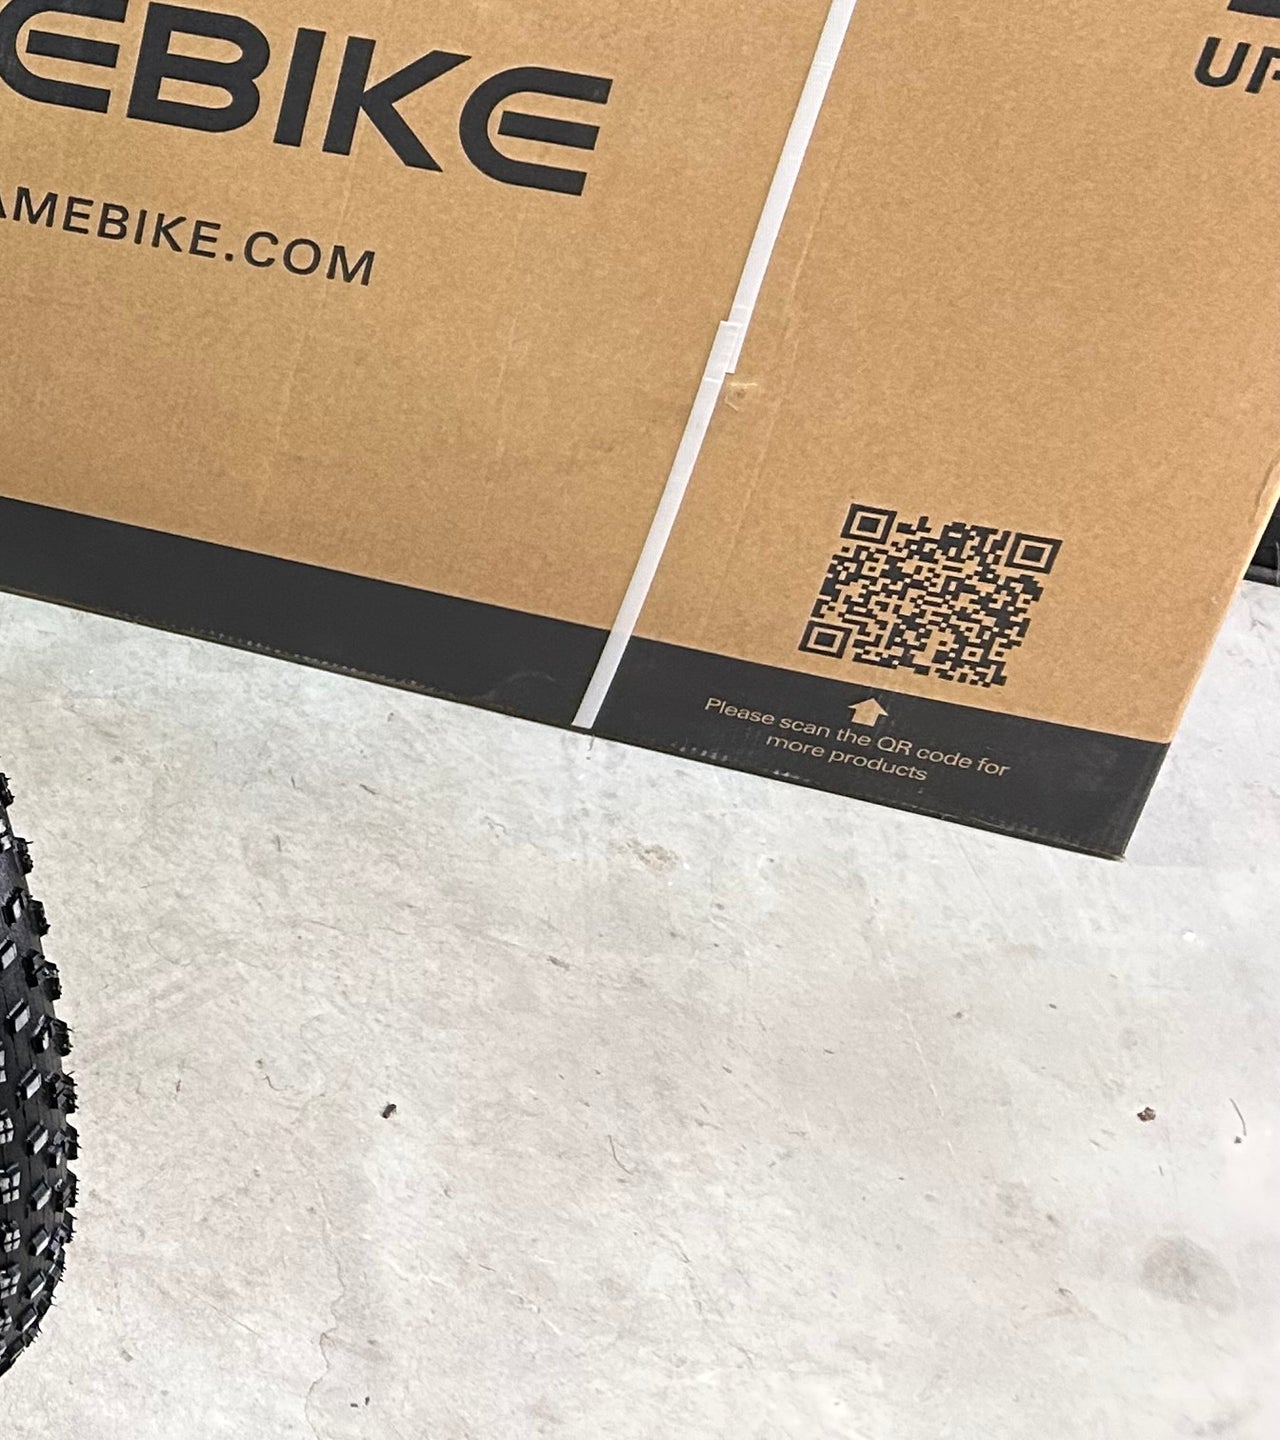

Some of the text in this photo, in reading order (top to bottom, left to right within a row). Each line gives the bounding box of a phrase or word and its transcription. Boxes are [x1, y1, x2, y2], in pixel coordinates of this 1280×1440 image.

[705, 696, 1013, 778] Please scan the QR code for
[766, 734, 929, 782] more products
